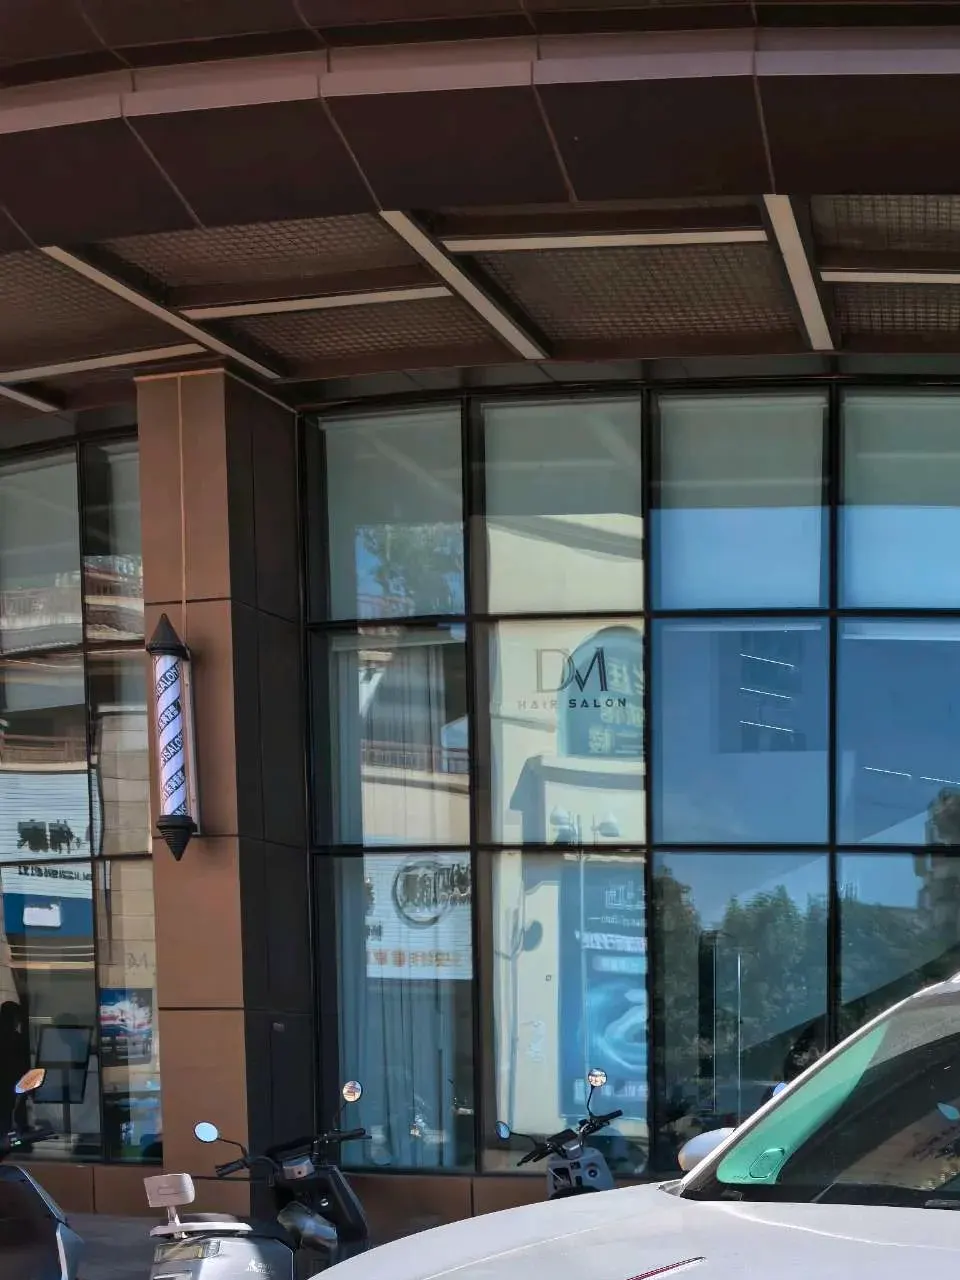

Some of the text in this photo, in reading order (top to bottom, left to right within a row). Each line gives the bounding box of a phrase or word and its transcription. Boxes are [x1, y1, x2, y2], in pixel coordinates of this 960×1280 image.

[534, 647, 608, 693] DM
[518, 698, 626, 710] HAIR SALON
